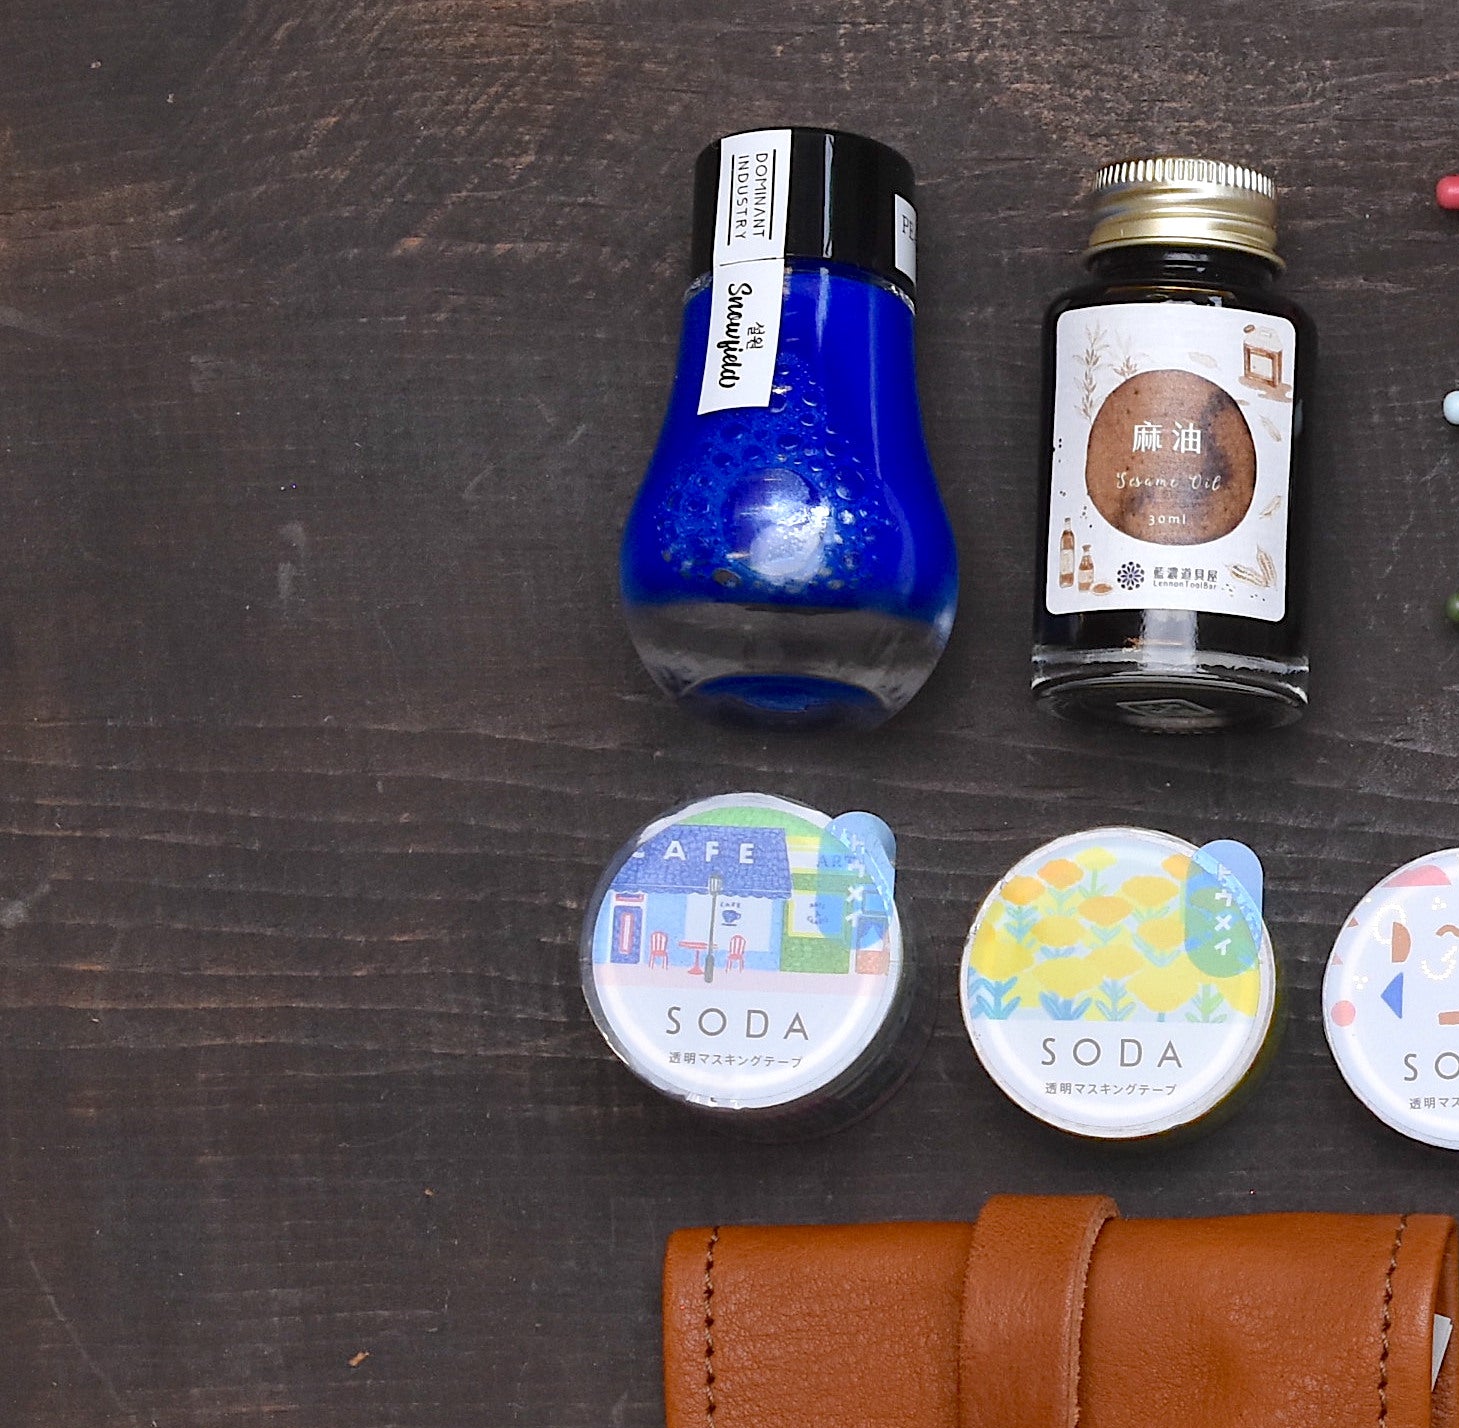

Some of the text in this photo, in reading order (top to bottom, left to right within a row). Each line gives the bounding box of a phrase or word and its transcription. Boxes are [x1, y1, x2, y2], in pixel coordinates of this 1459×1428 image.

[734, 155, 750, 240] INDUSTRY
[752, 153, 768, 237] DOMINANT
[717, 283, 753, 389] Snowfield
[1132, 420, 1201, 454] 麻油
[1116, 471, 1222, 491] Sesame Oil
[1148, 514, 1187, 526] 30ml
[1153, 566, 1218, 583] 藍濃道具屋
[1153, 580, 1217, 591] LennonToolBar
[632, 840, 755, 865] AFE
[1214, 863, 1232, 956] トウメイ
[666, 1006, 809, 1041] SODA
[669, 1051, 803, 1069] 透明マスキングテープ
[1041, 1037, 1183, 1069] SODA
[1045, 1082, 1177, 1096] 透明マスキングテープ
